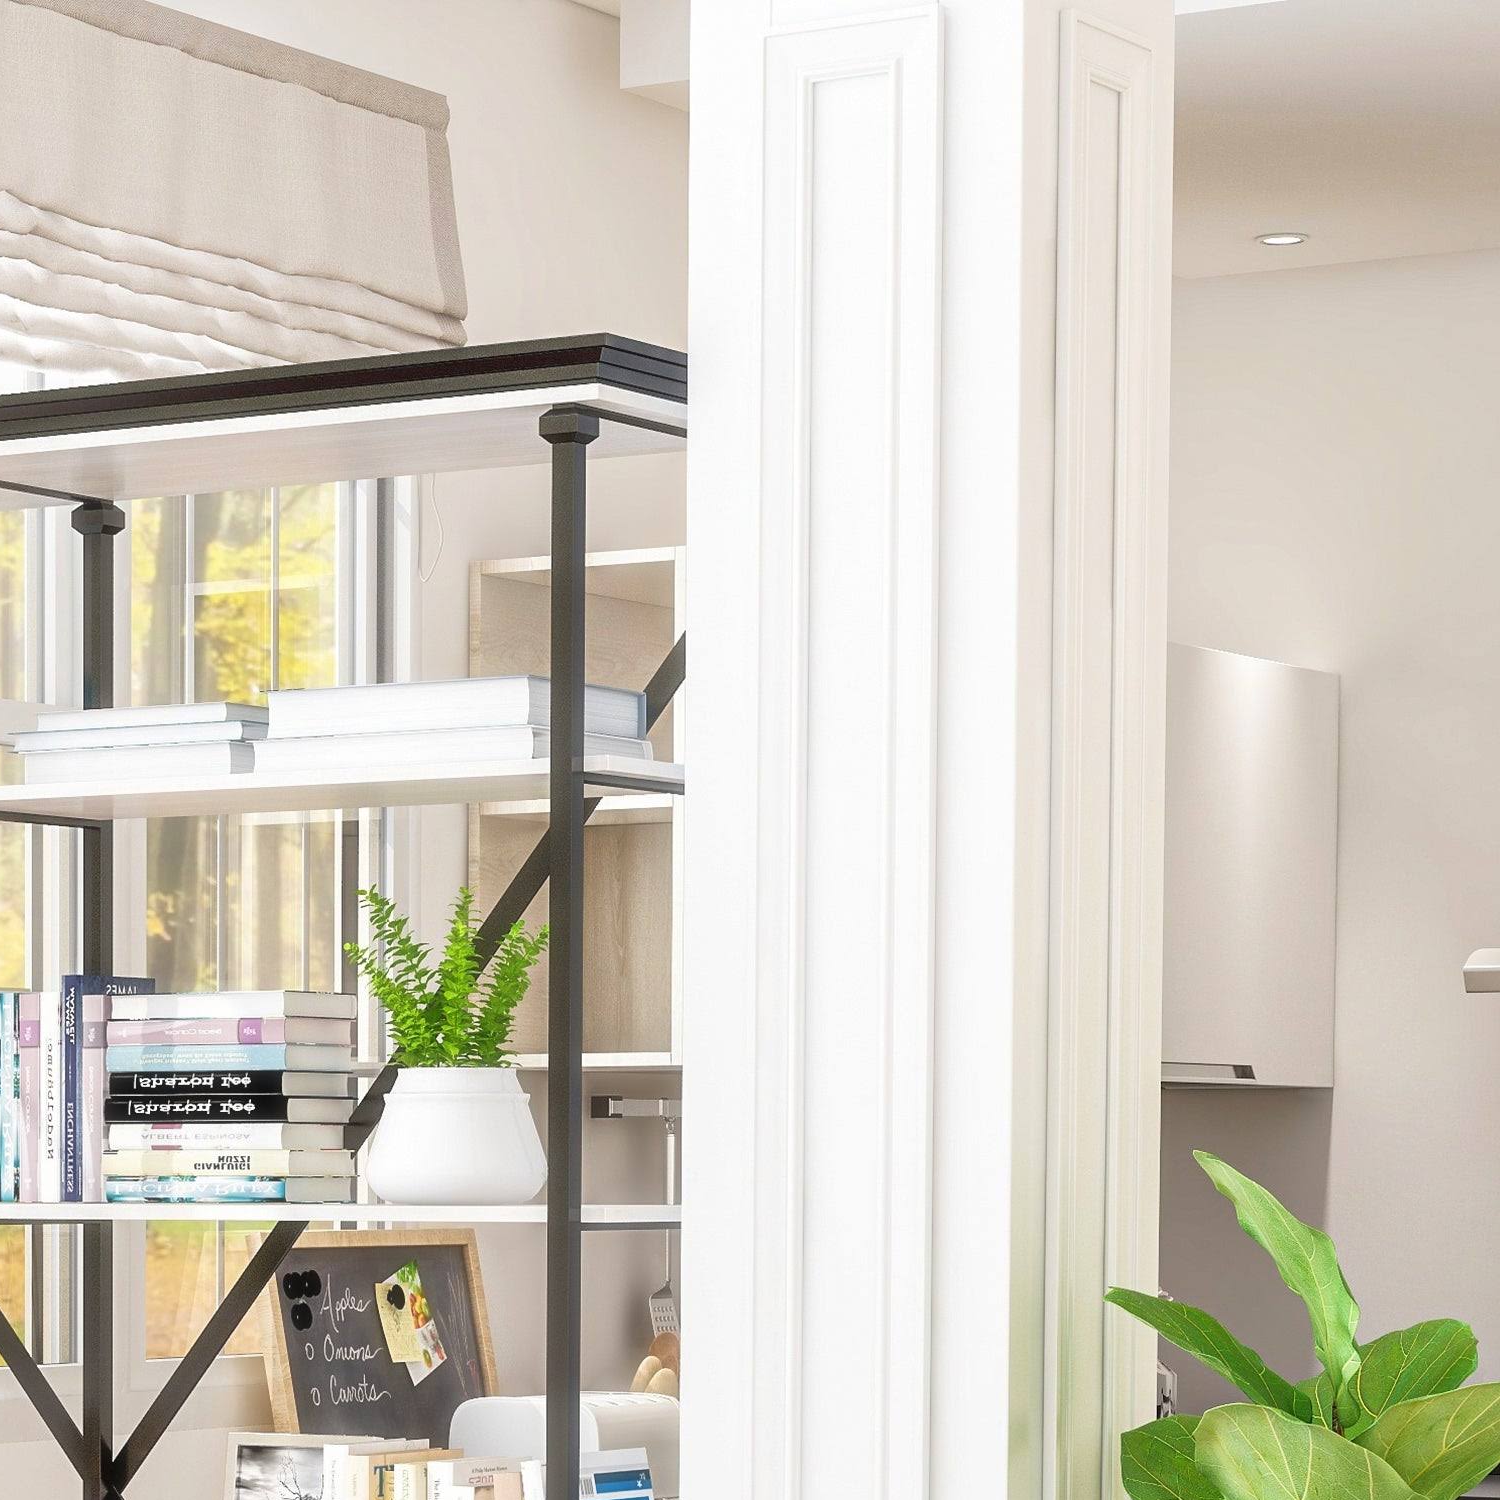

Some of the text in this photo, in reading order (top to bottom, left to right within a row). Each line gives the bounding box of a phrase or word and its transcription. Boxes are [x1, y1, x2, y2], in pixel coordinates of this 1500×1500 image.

[320, 1273, 371, 1333] Apples
[324, 1334, 383, 1362] Onions
[330, 1374, 391, 1405] Carrots
